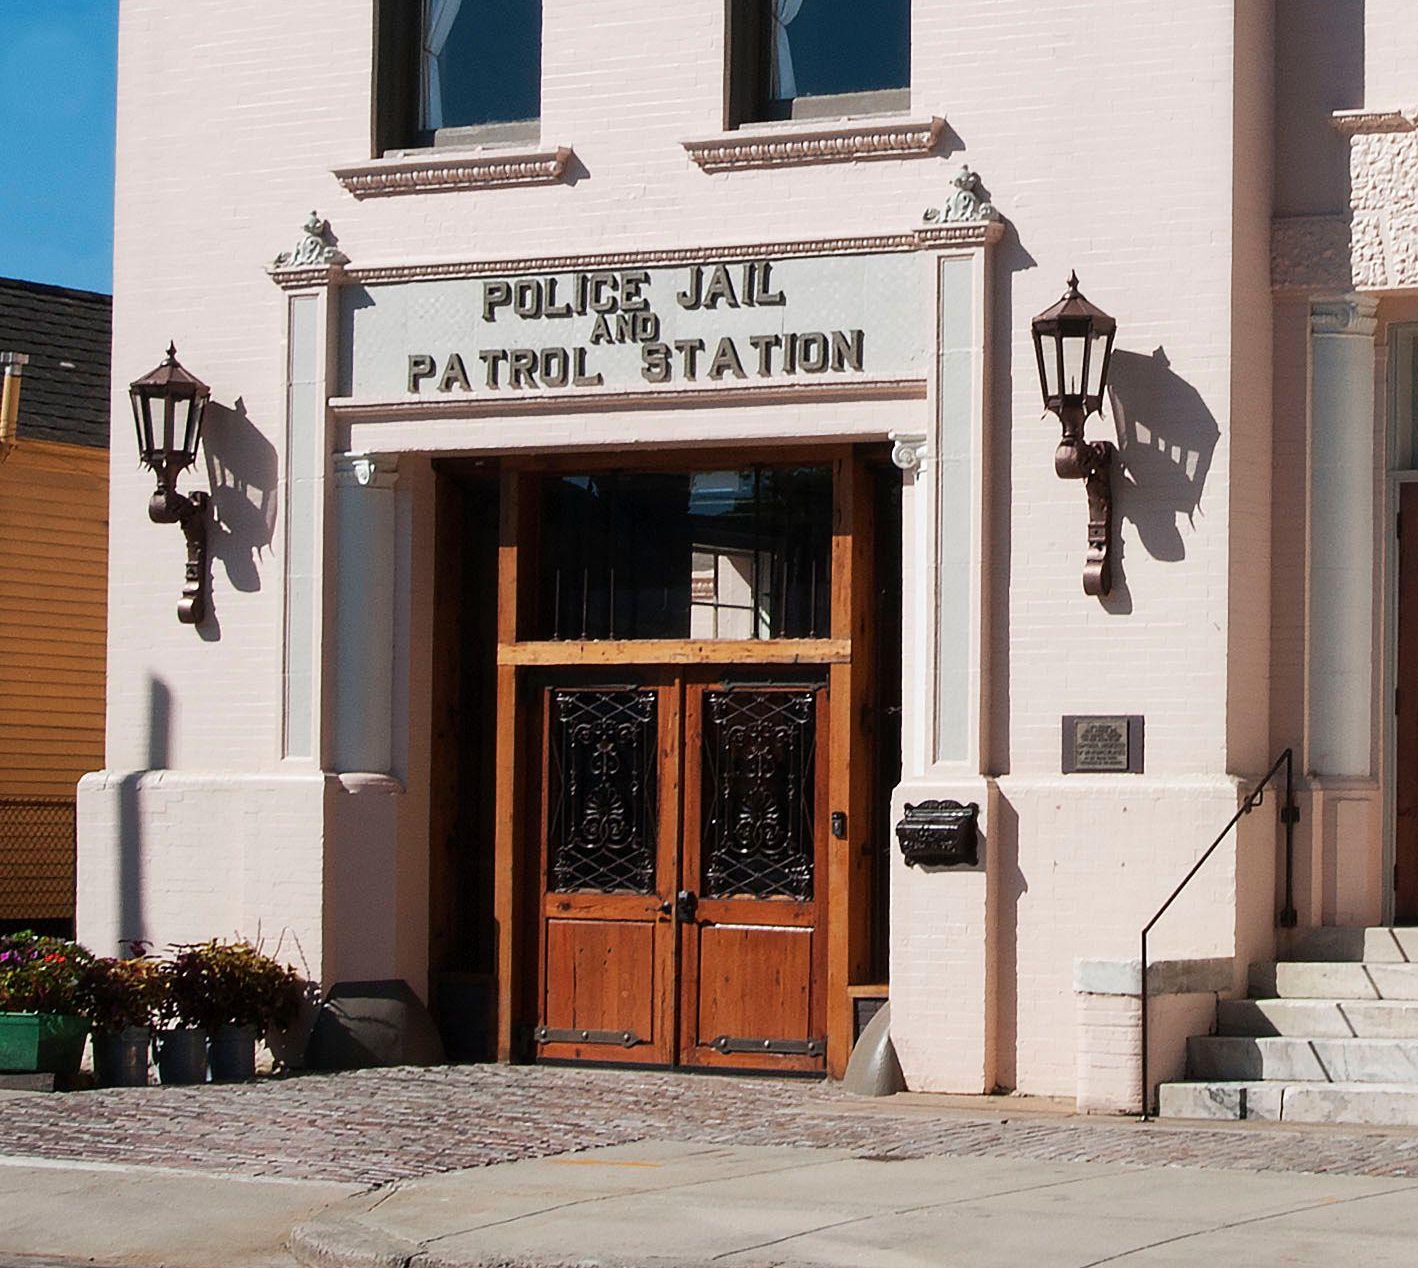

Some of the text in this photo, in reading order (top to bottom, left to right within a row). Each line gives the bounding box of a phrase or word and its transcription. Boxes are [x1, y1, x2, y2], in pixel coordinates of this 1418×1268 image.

[482, 261, 786, 322] POLICE JAIL
[589, 312, 660, 344] AND
[407, 329, 865, 394] PATROL STATION
